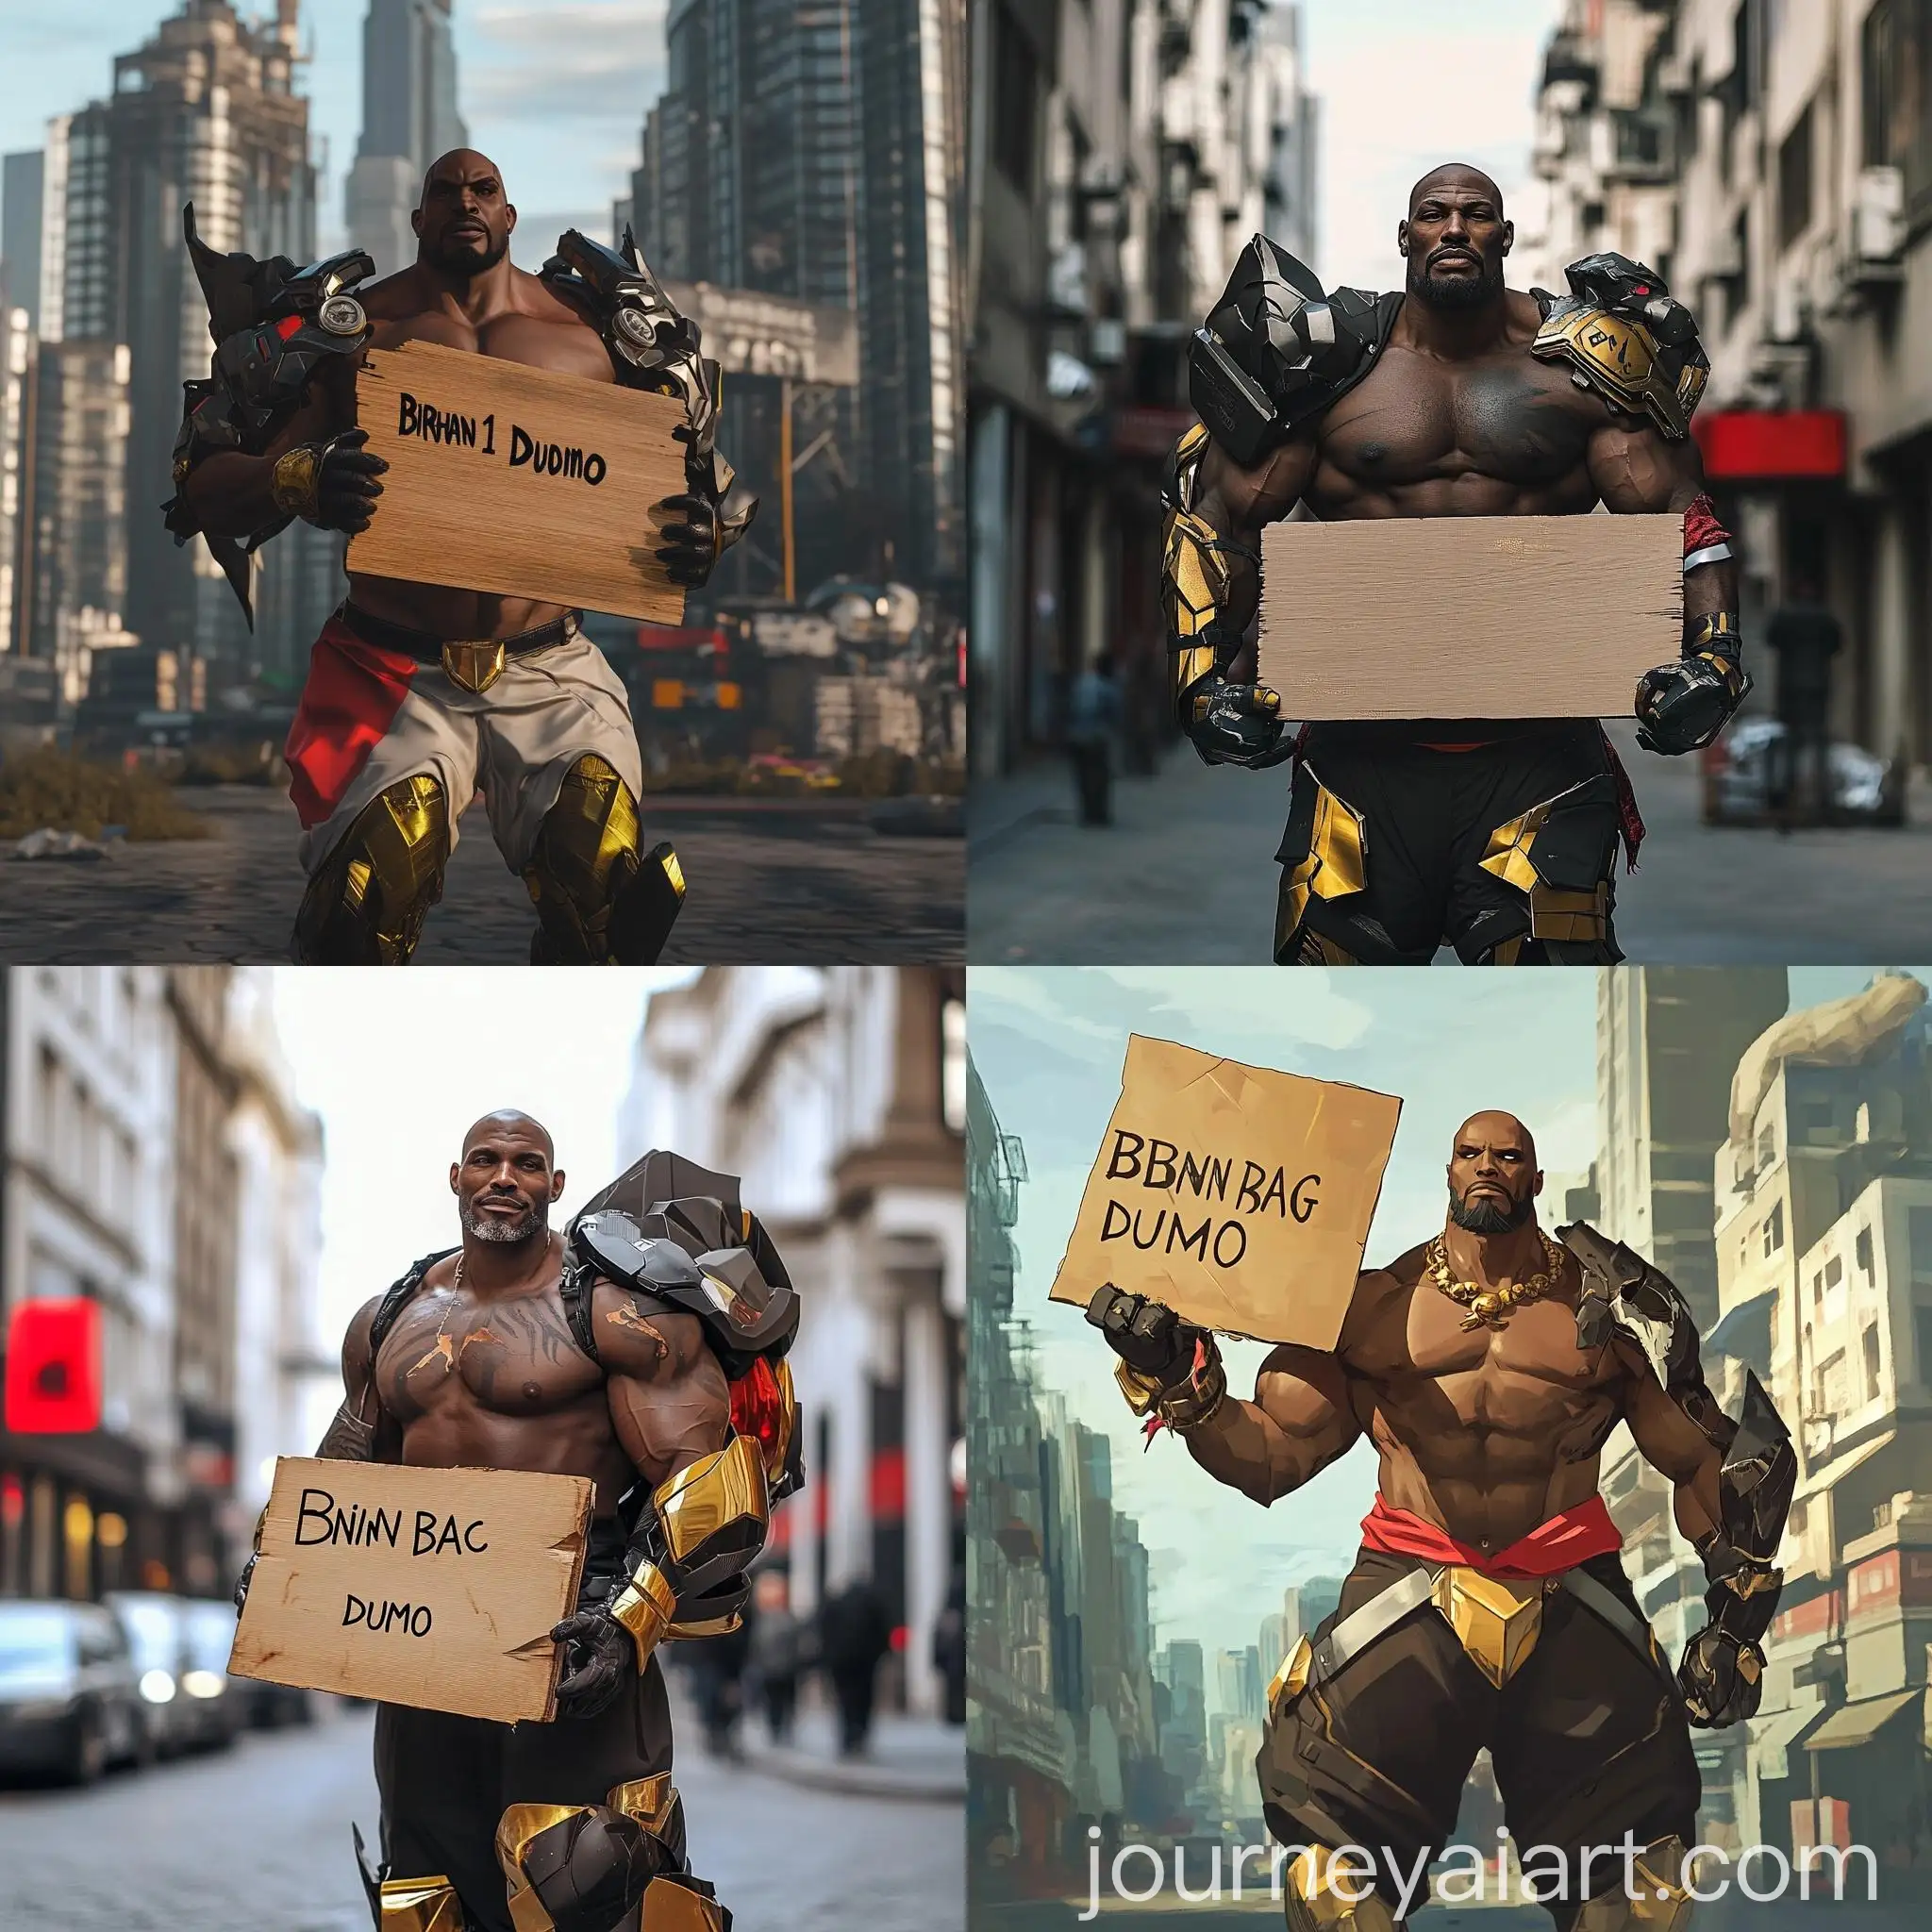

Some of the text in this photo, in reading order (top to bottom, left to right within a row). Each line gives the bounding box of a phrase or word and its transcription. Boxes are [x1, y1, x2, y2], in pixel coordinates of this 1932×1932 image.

[1235, 1160, 1321, 1224] BAG
[1101, 1199, 1246, 1268] DUMO
[412, 1510, 489, 1557] BAC
[341, 1594, 432, 1638] DUMO
